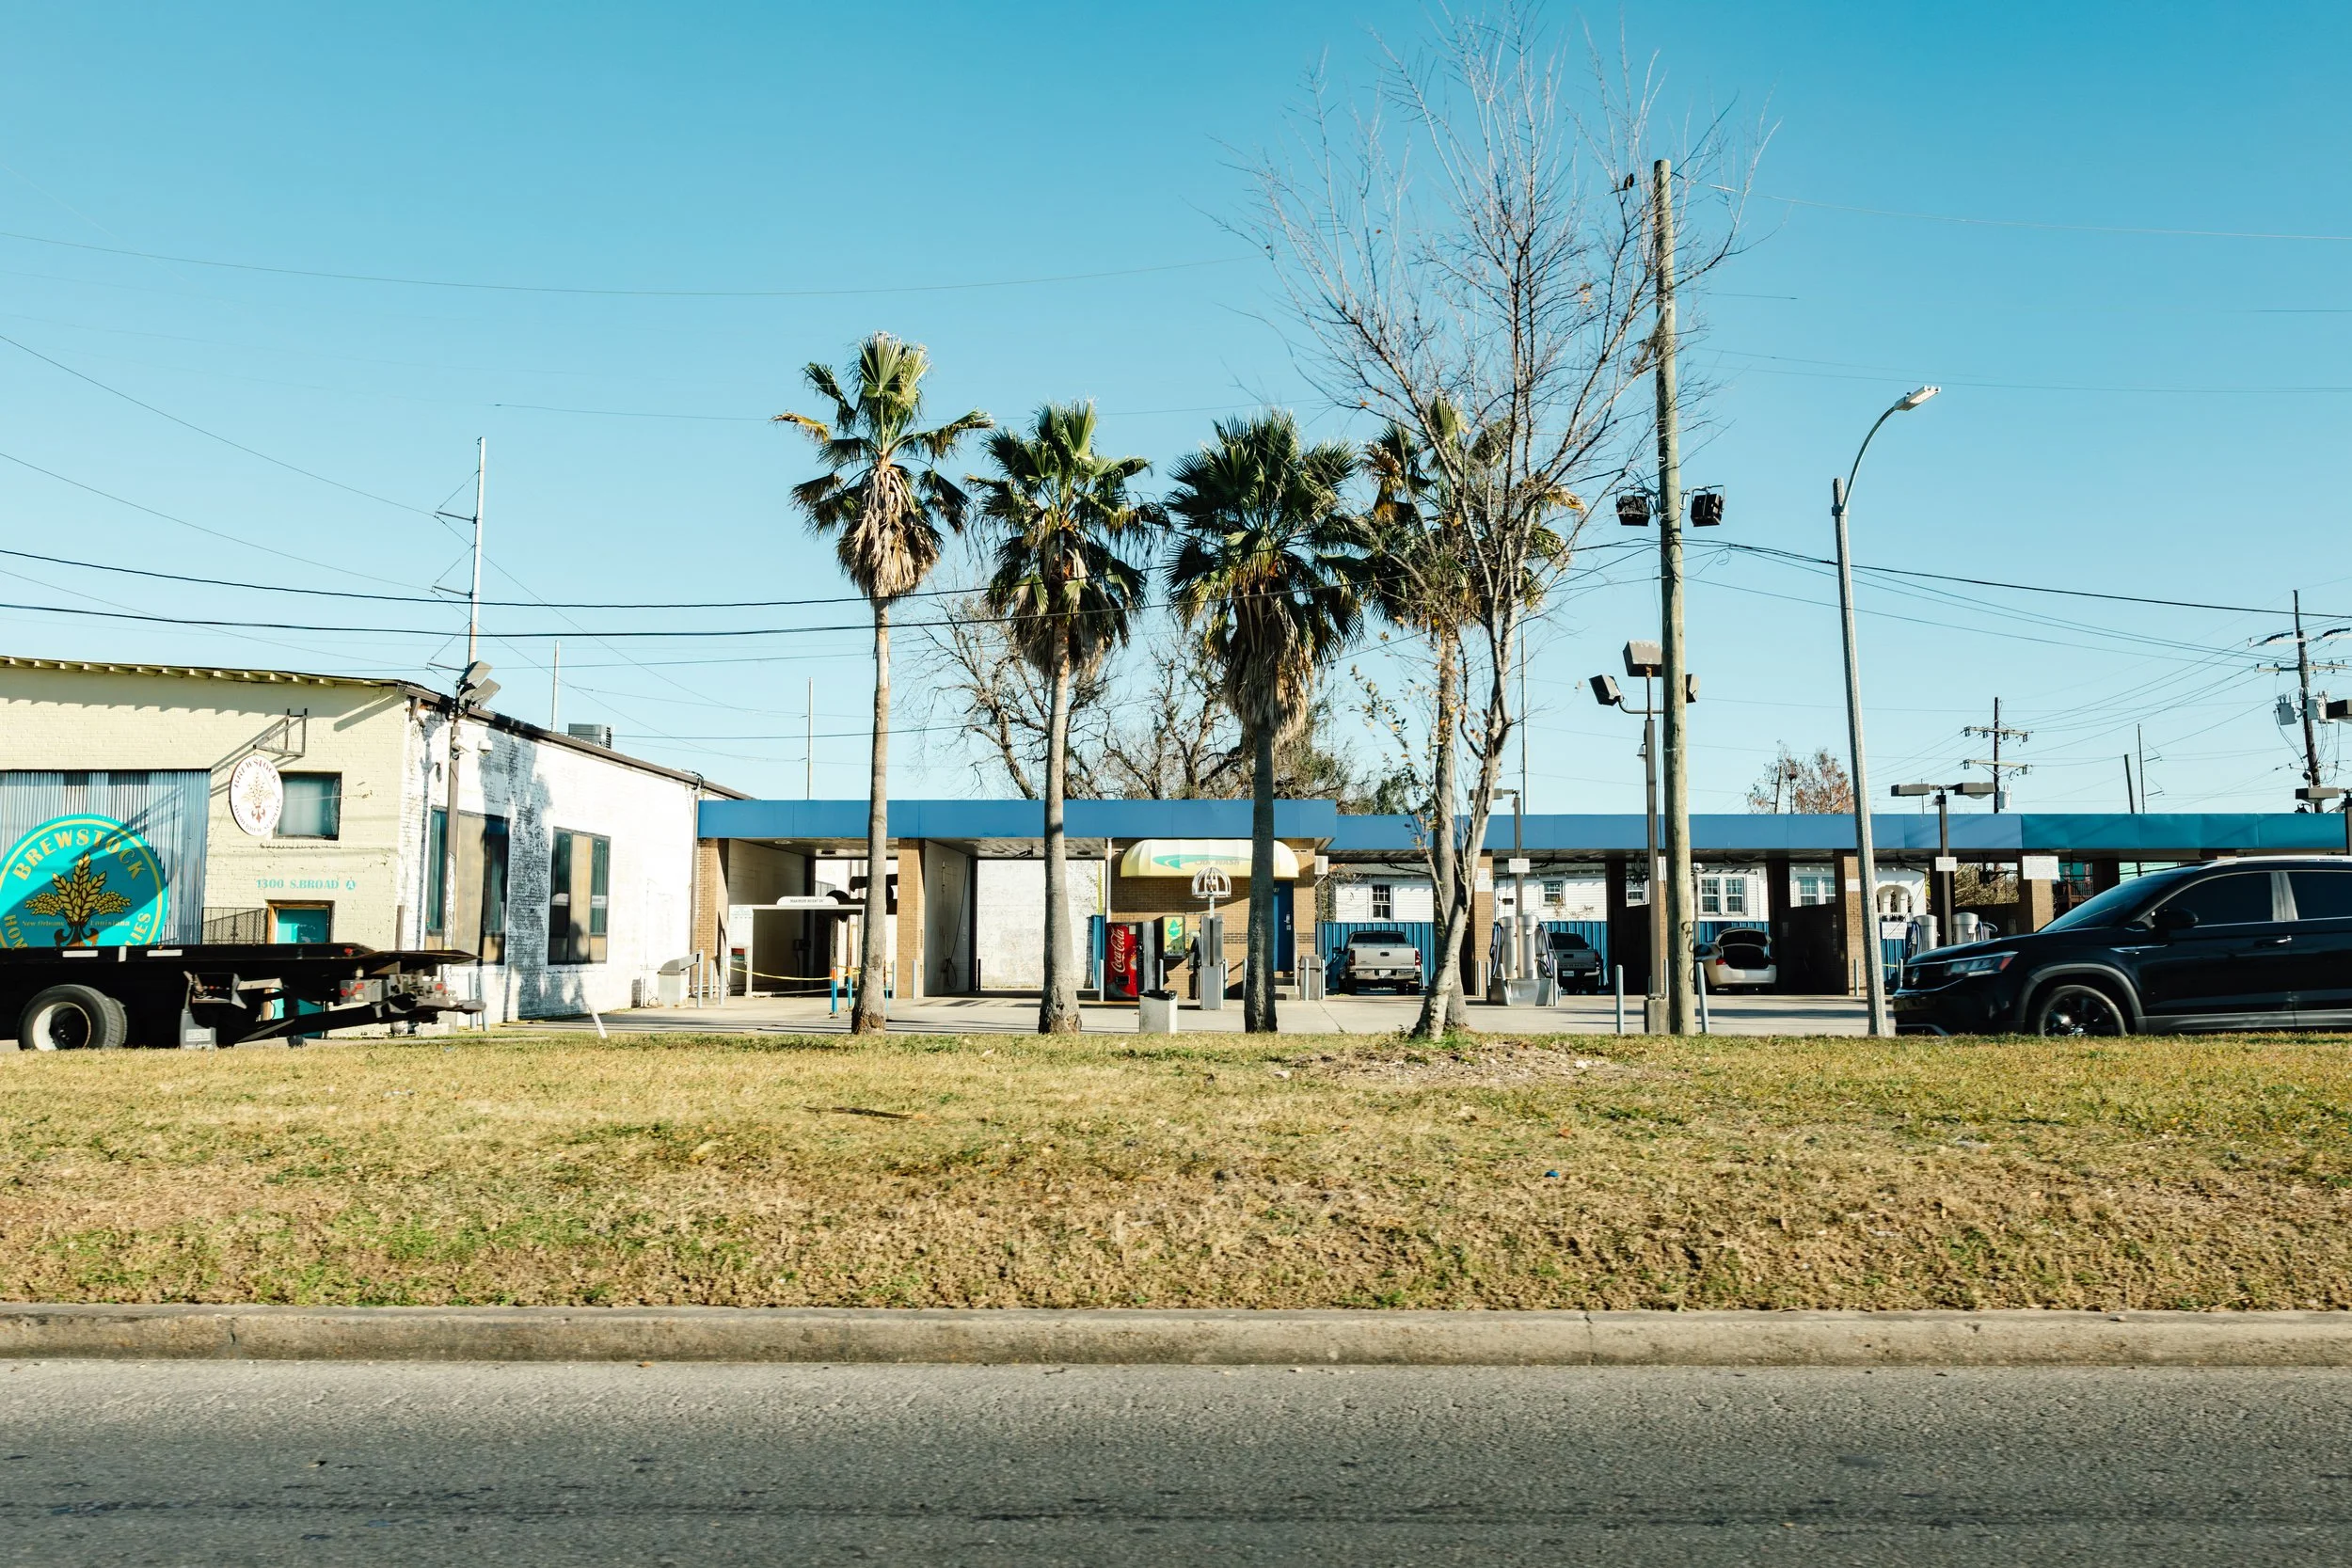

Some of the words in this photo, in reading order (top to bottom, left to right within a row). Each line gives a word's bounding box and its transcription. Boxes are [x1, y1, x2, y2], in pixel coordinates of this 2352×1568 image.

[12, 829, 148, 880] BREWSTOCK
[256, 879, 284, 889] 1300
[290, 879, 339, 889] S.BROAD
